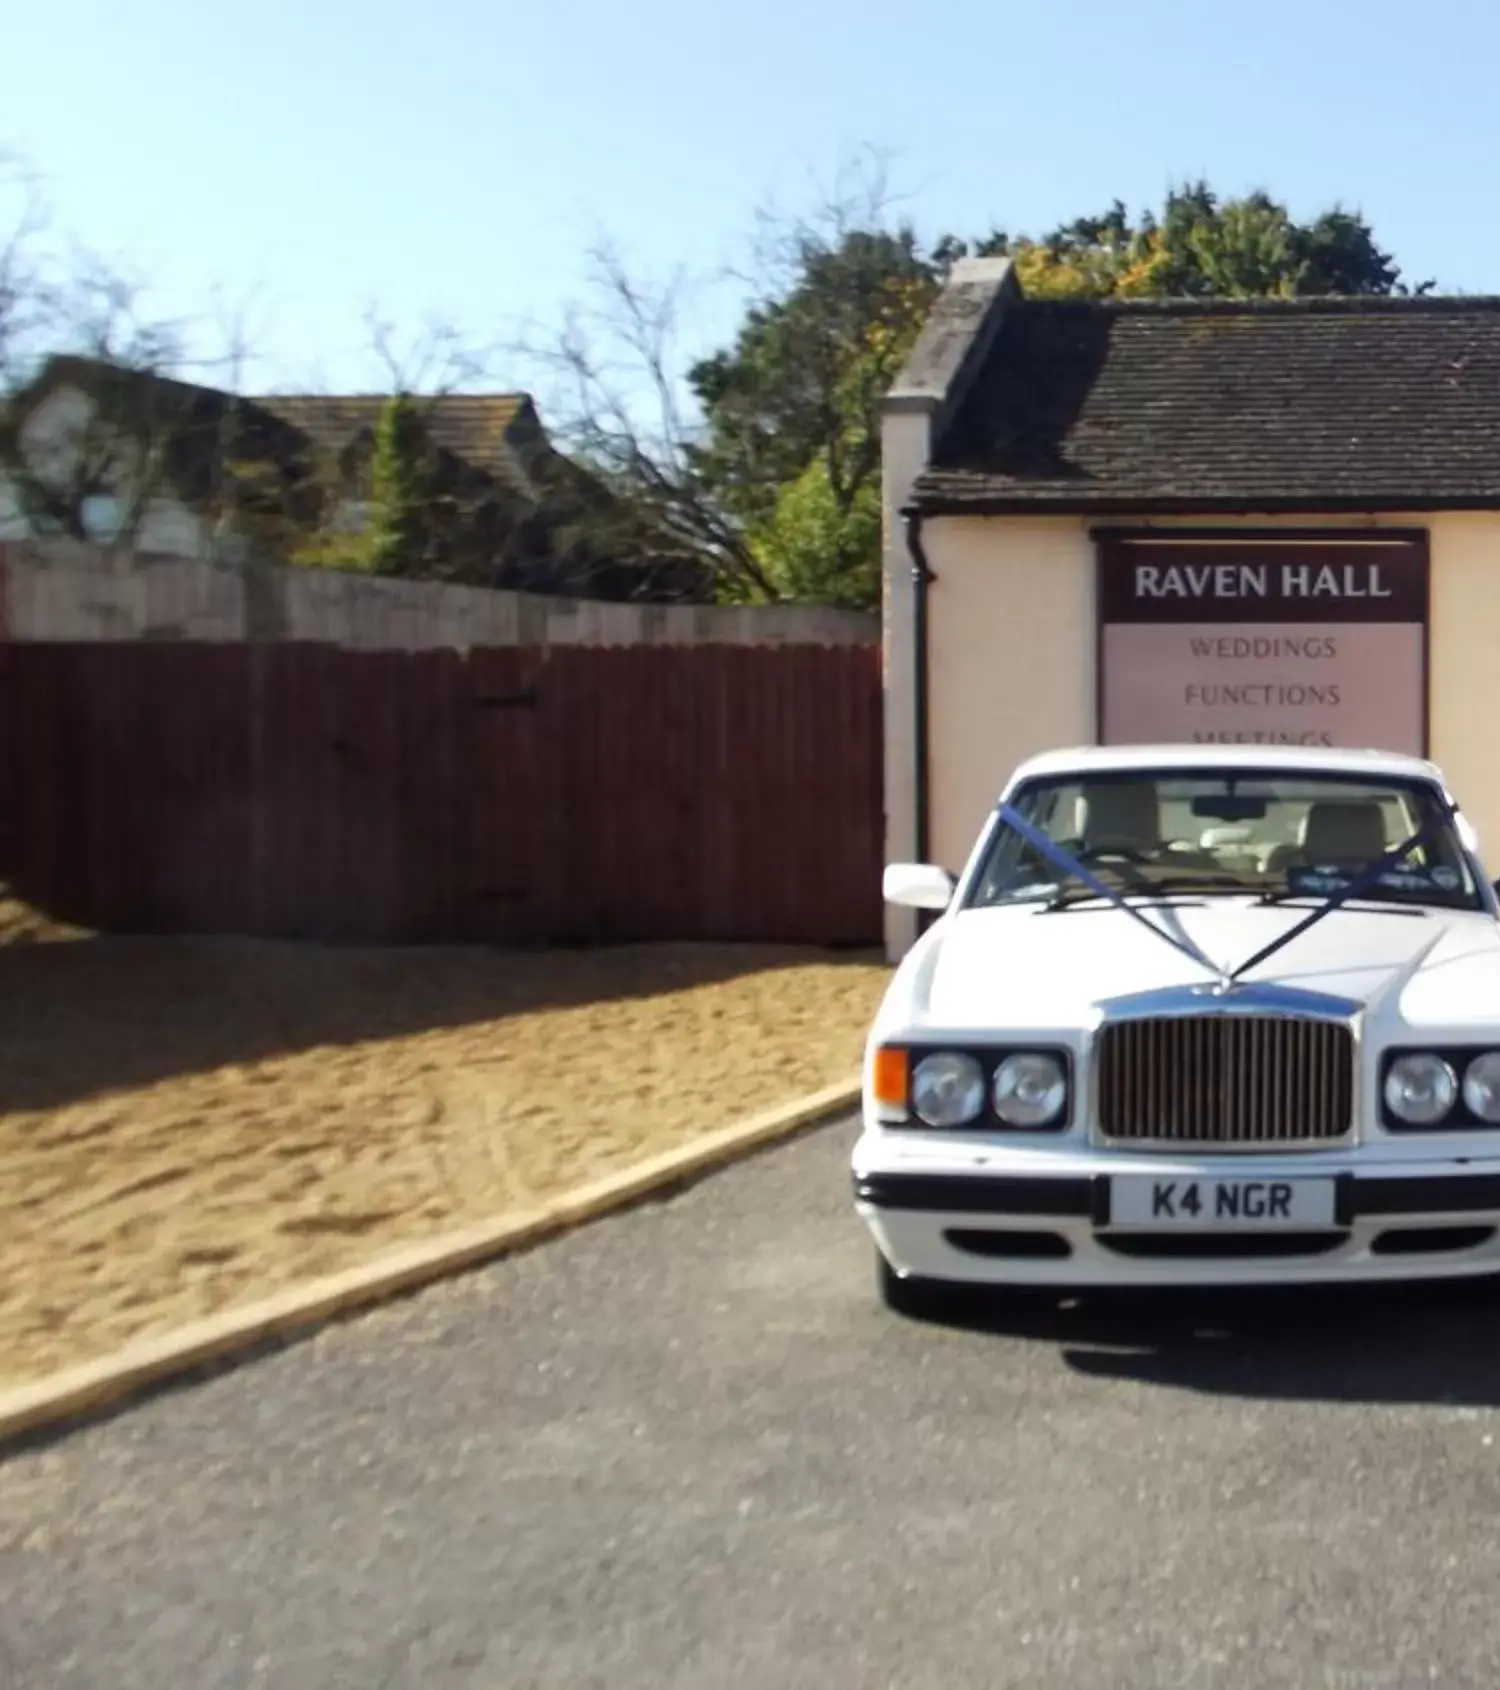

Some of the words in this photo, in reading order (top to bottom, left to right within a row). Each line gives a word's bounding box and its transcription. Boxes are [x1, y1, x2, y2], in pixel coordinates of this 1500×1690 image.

[1135, 565, 1267, 597] RAVEN
[1282, 565, 1391, 597] HALL
[1190, 637, 1337, 658] WEDDINGS
[1185, 683, 1340, 706] FUNCTIONS
[1153, 1182, 1202, 1218] K4
[1215, 1183, 1293, 1218] NGR
